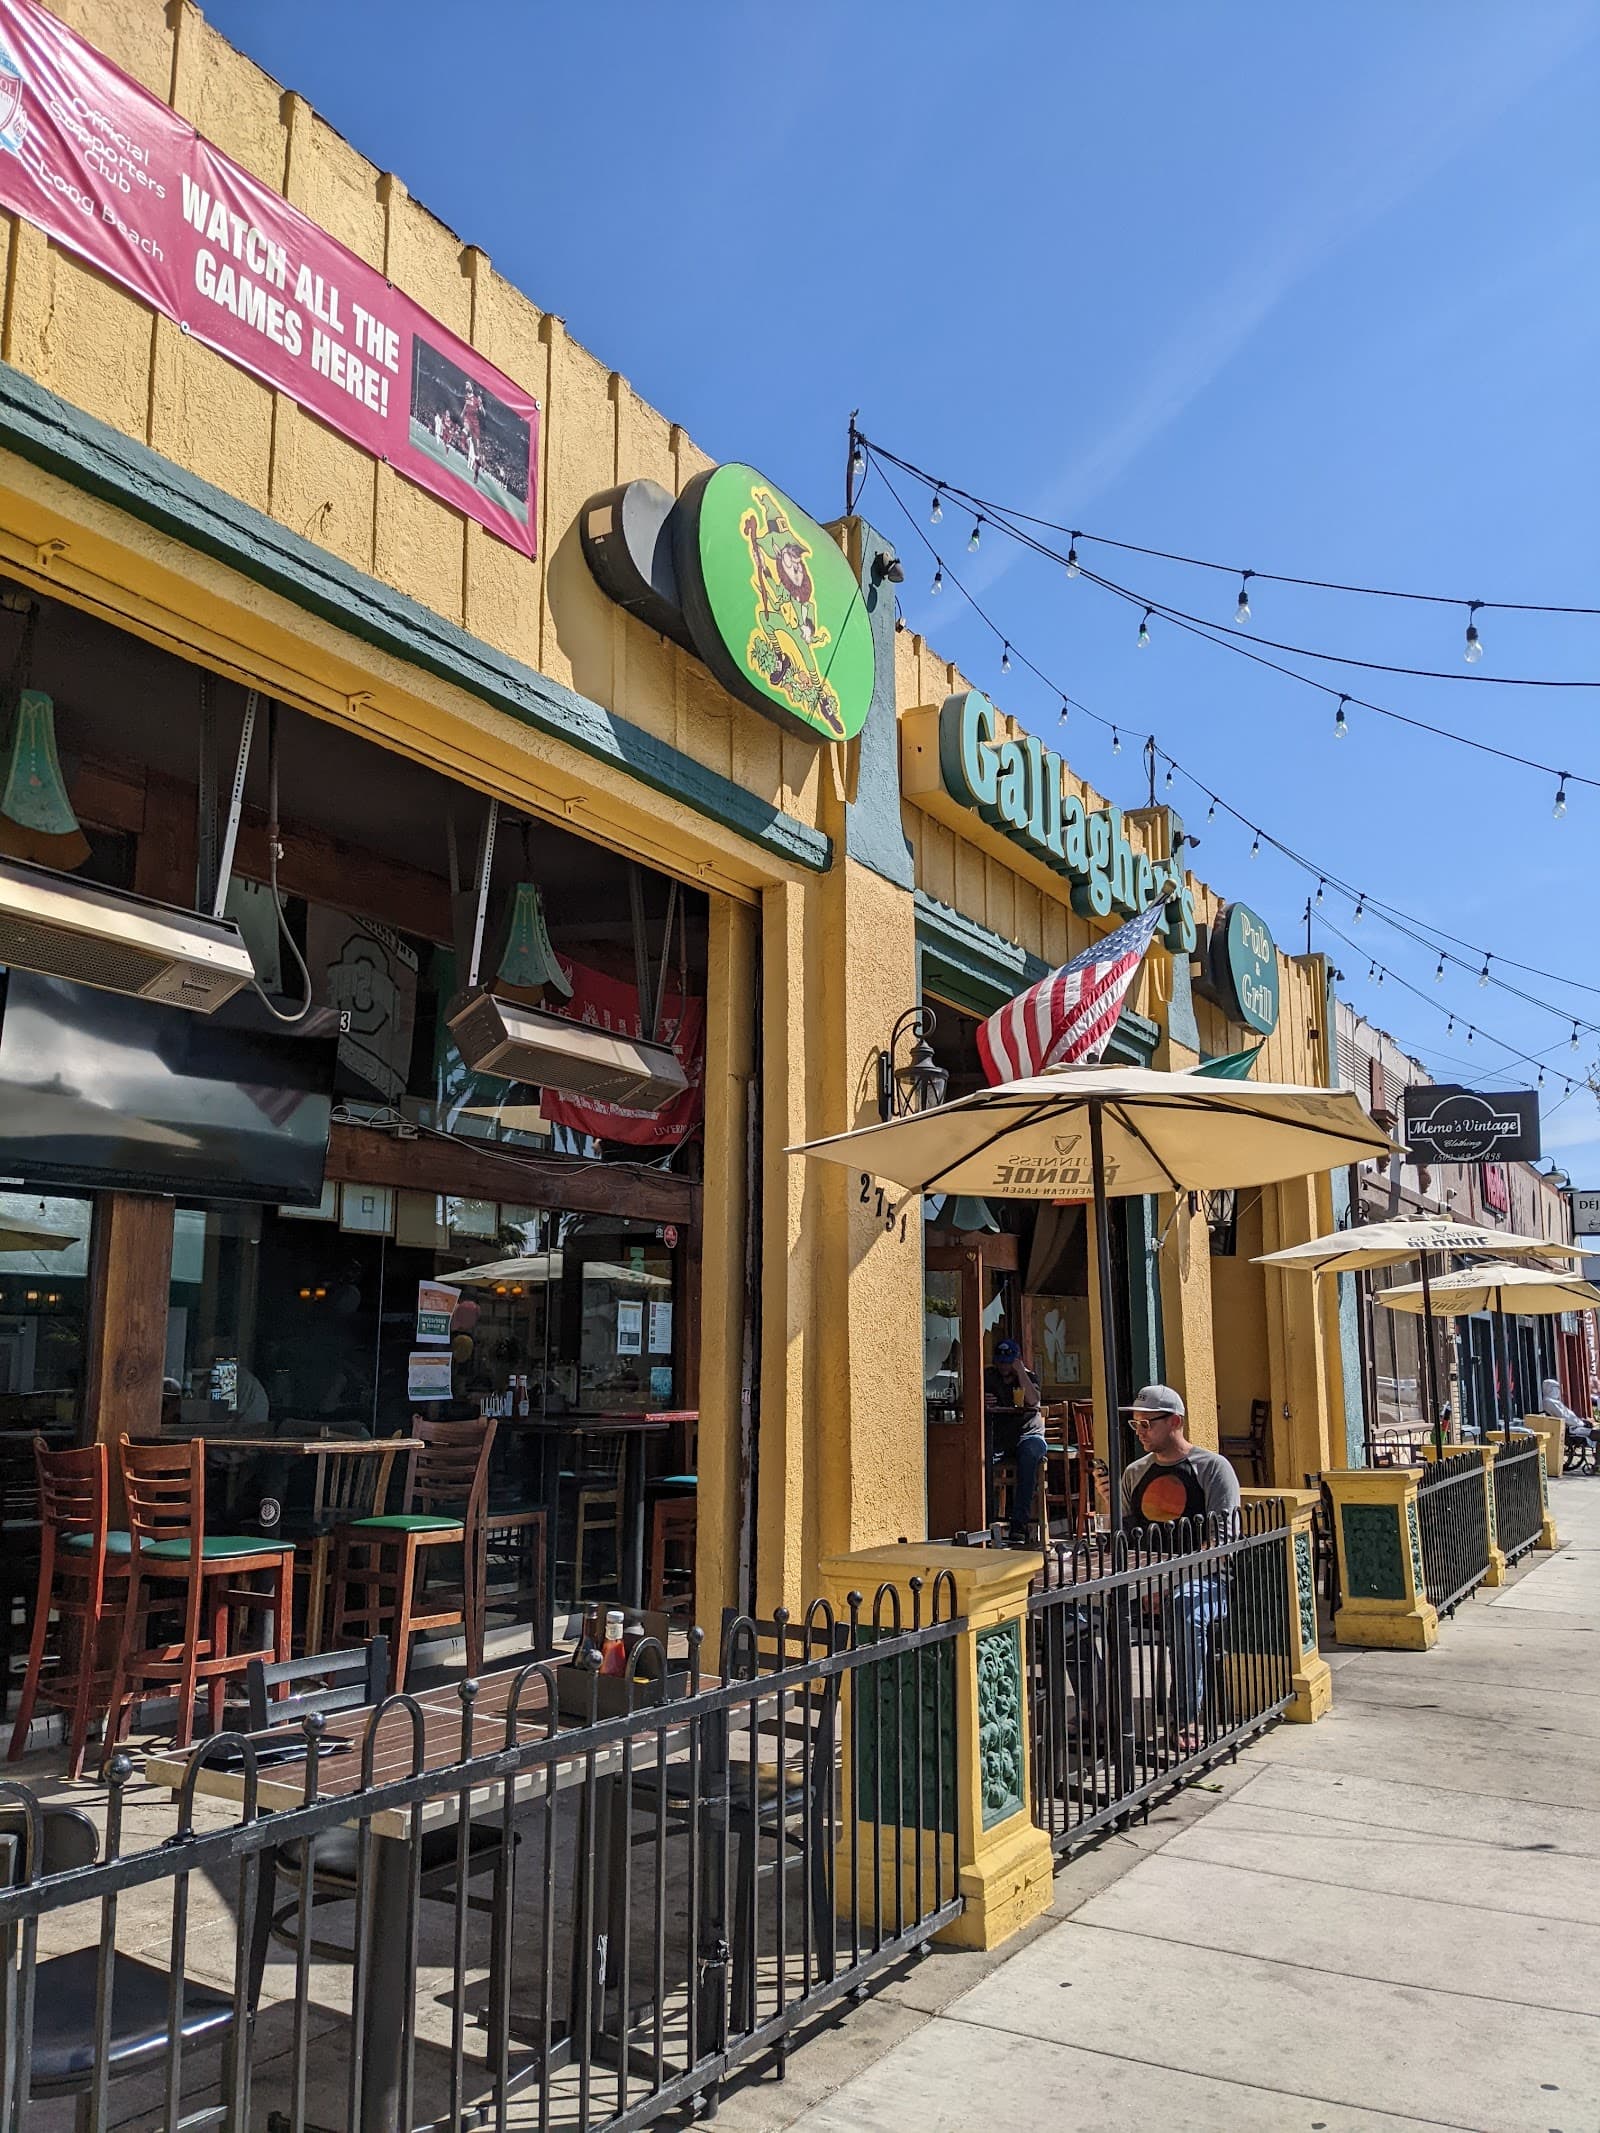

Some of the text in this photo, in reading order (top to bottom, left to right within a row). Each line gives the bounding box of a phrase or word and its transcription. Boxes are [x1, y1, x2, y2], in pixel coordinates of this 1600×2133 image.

[50, 100, 166, 199] Supporters
[72, 96, 150, 166] Official
[84, 149, 131, 194] Club
[39, 159, 164, 262] Long Beach
[182, 172, 399, 374] WATCH ALL THE
[195, 248, 389, 418] GAMES HERE!
[1240, 911, 1270, 963] Pub
[341, 1012, 349, 1031] 3
[1241, 973, 1273, 1026] Grill
[1410, 1119, 1518, 1135] Memo's Vintage
[859, 1172, 907, 1244] 2751
